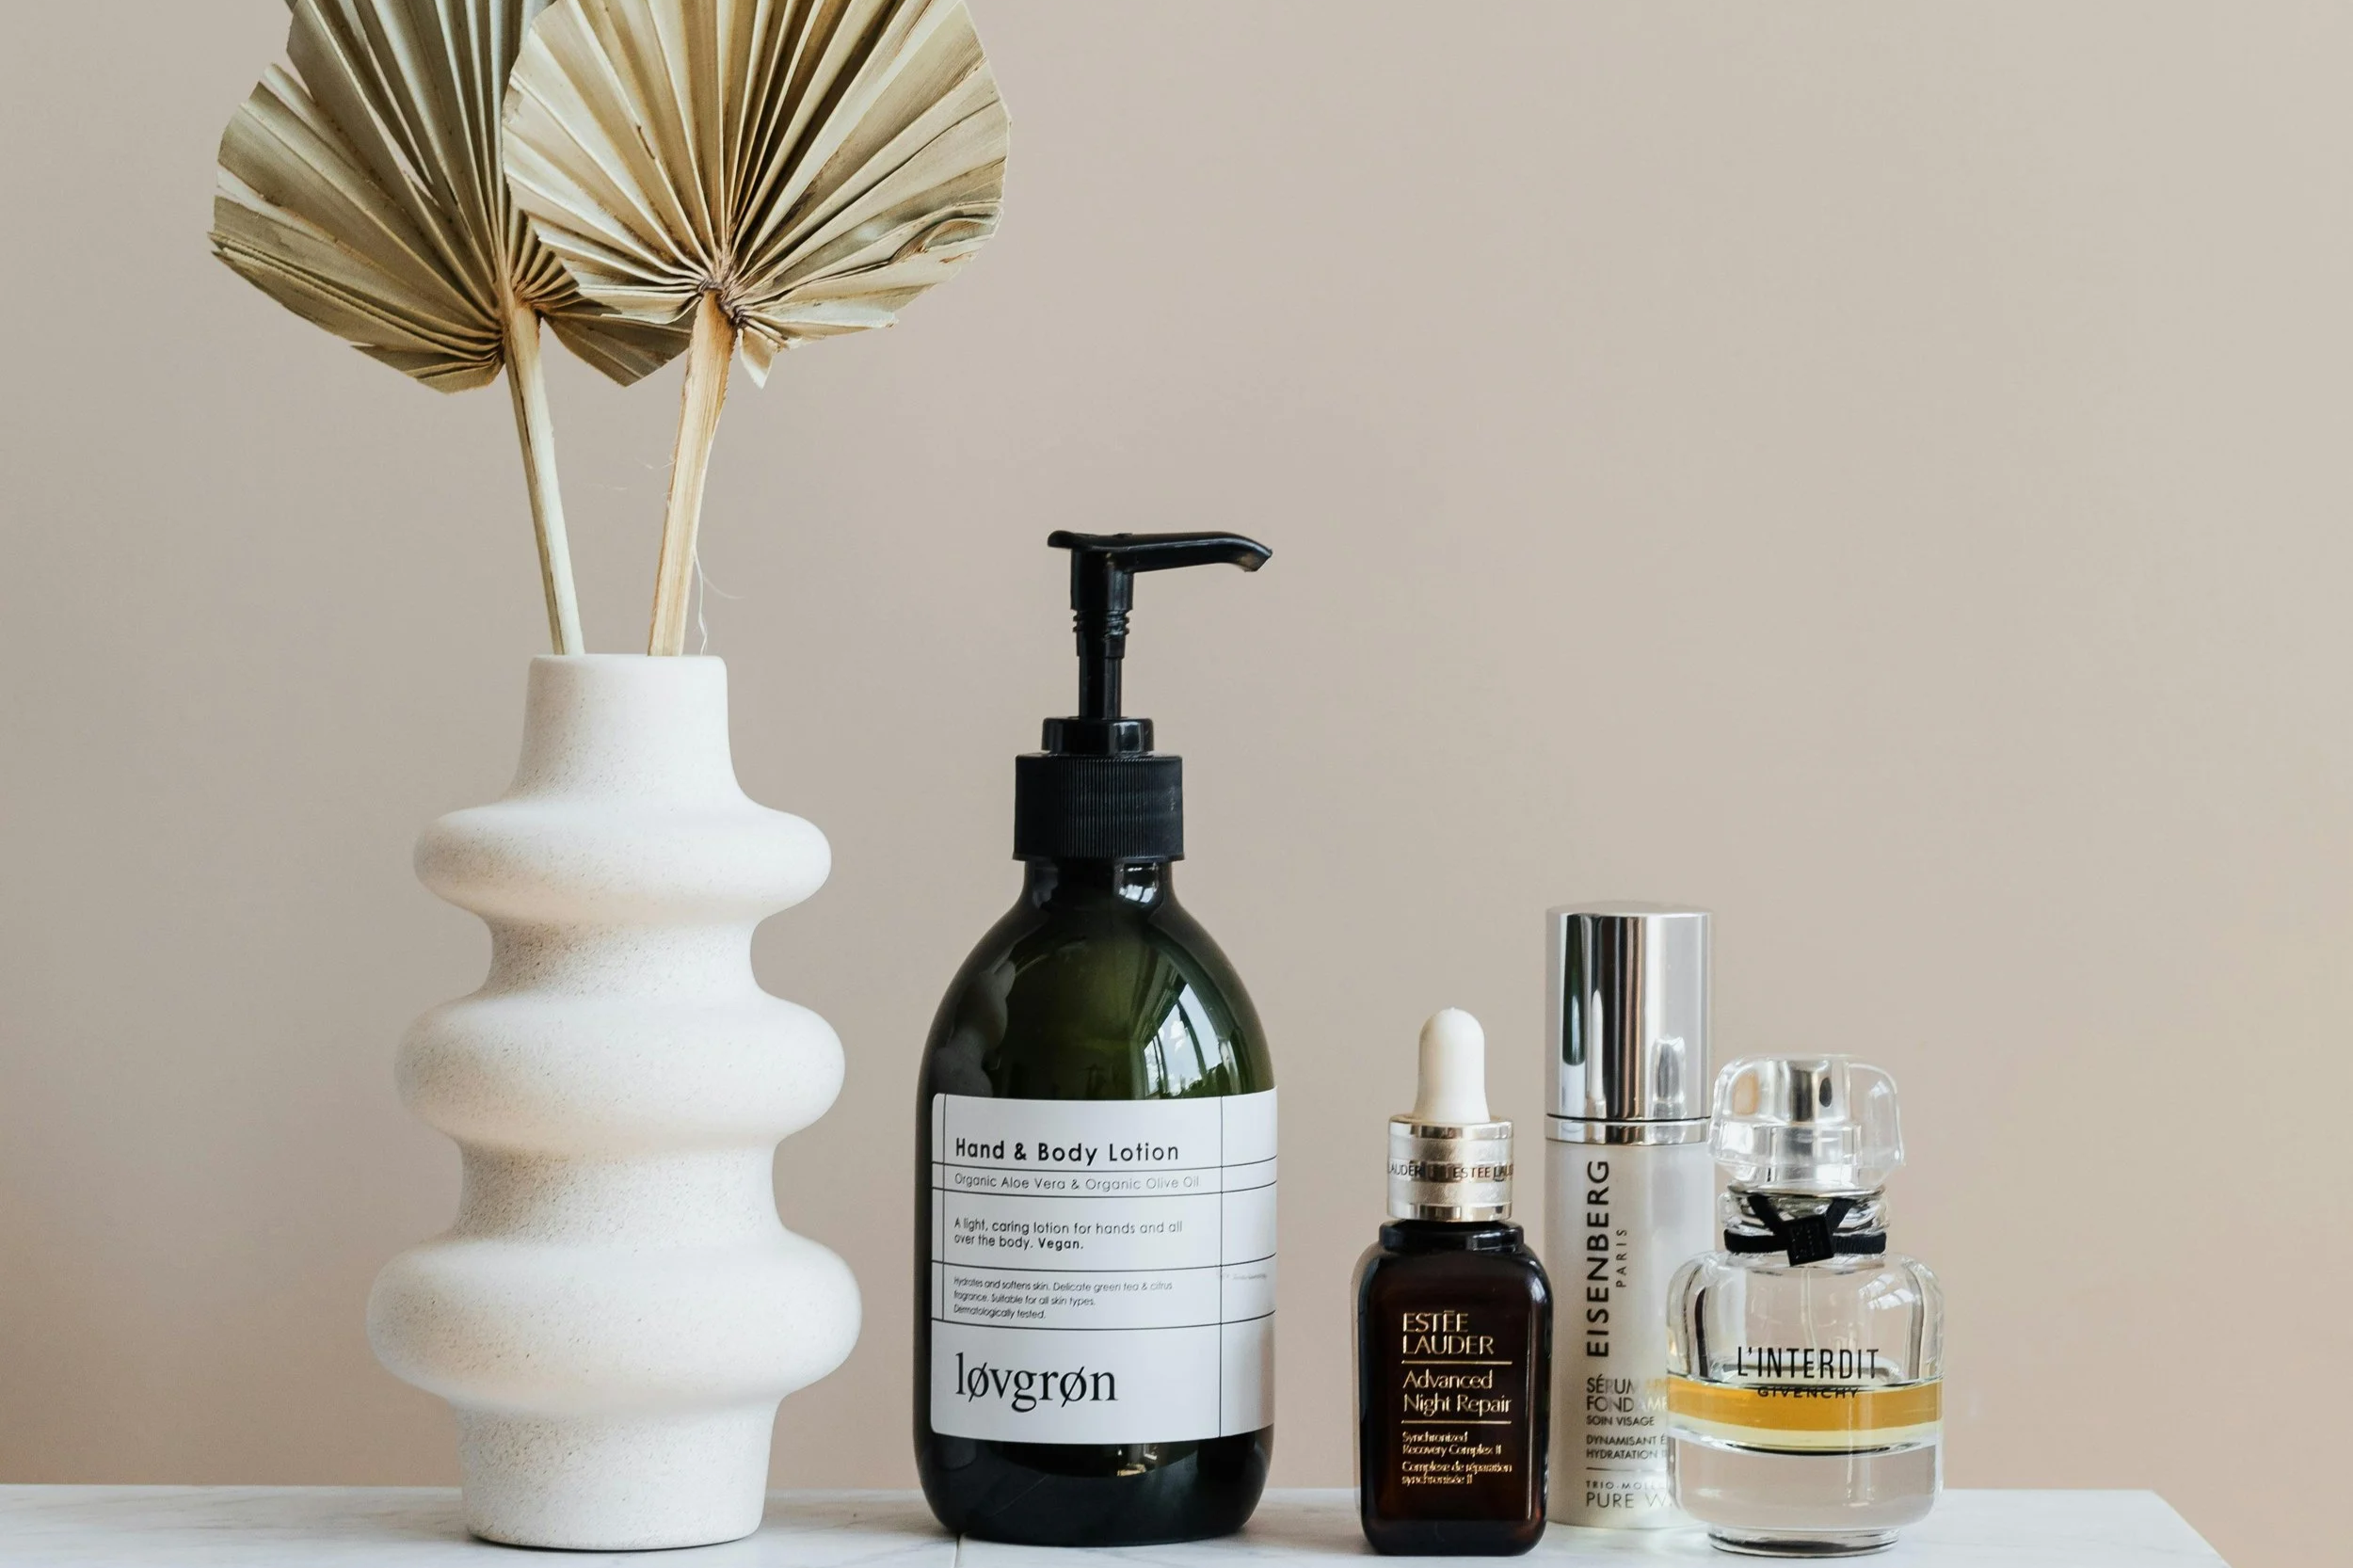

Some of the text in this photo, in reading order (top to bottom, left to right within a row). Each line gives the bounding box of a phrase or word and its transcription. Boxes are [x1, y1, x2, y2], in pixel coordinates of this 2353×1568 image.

[955, 1137, 1178, 1166] Hand & Body Lotion
[954, 1173, 1199, 1192] Organic Aloe Vera & Organic Olive Oil
[954, 1217, 1182, 1236] A light, caring lotion for hands and all
[954, 1233, 1084, 1252] over the body. Vegan.
[1587, 1160, 1609, 1357] EISENBERG
[1616, 1228, 1627, 1288] PARIS
[984, 1279, 1000, 1288] and
[1002, 1280, 1031, 1290] softens
[1053, 1282, 1092, 1291] Delicate
[1093, 1284, 1122, 1293] green
[1123, 1283, 1139, 1291] tea
[1150, 1281, 1173, 1290] citrus
[991, 1293, 1023, 1304] Suitable
[1025, 1295, 1037, 1304] for
[1039, 1296, 1048, 1304] all
[1050, 1296, 1067, 1305] skin
[1402, 1335, 1495, 1355] LAUDER
[955, 1352, 1118, 1413] løvgrøn
[1402, 1368, 1493, 1389] Advanced
[1757, 1386, 1859, 1400] GIVENCHY
[1403, 1392, 1512, 1417] Night Repair
[1586, 1415, 1655, 1427] SOIN VISAGE
[1402, 1431, 1468, 1445] Synchronized
[1586, 1434, 1657, 1447] DYNAMISANT
[1402, 1444, 1448, 1458] Recovery
[1449, 1443, 1494, 1458] Complex
[1586, 1448, 1657, 1460] HYDRATATION
[1586, 1492, 1635, 1508] PURE
